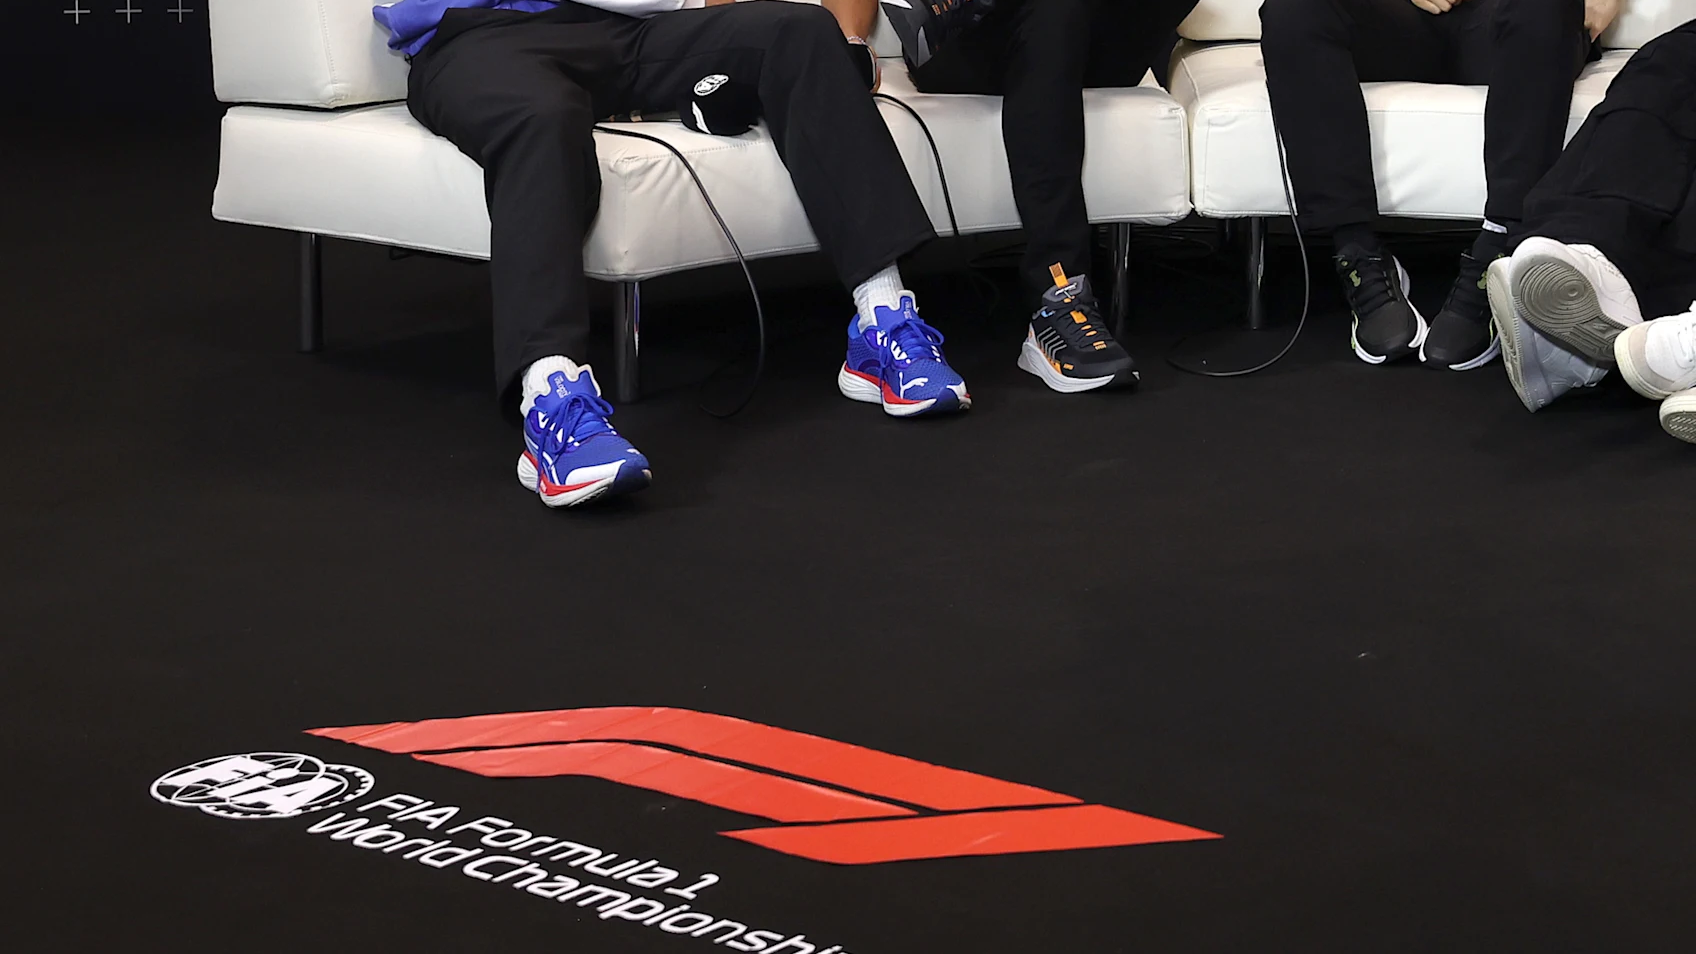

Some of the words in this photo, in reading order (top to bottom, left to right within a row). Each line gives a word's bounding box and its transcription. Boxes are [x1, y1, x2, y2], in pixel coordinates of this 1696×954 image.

[307, 812, 484, 868] World
[357, 793, 460, 830] FIA
[446, 816, 679, 888] Formula
[664, 873, 720, 900] 1
